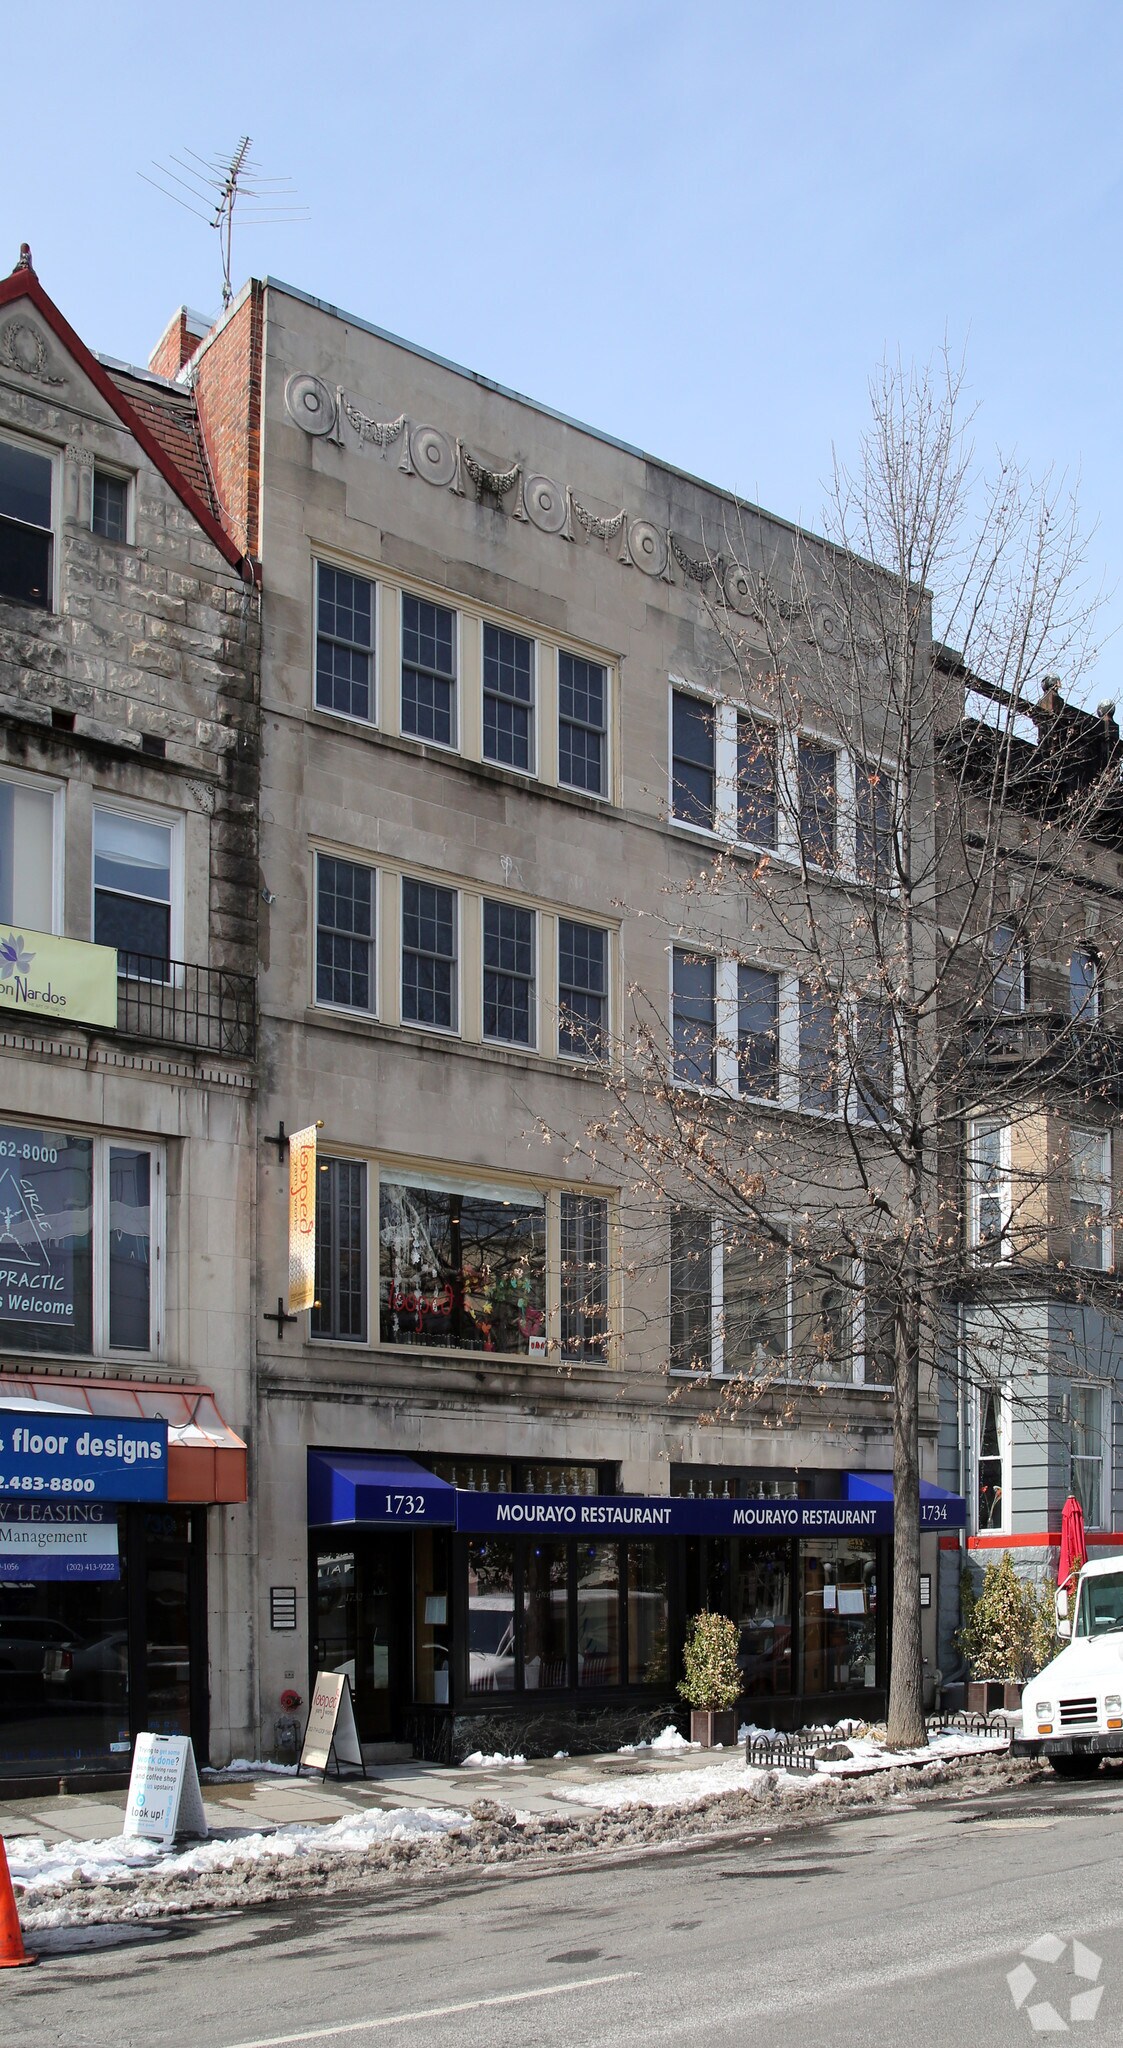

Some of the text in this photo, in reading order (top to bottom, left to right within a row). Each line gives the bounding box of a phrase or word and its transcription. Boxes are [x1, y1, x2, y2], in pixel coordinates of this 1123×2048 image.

[14, 975, 67, 1007] Nardos
[0, 1140, 57, 1164] 62-8000
[290, 1145, 315, 1235] looped
[20, 1179, 52, 1232] CIRCLE
[8, 1294, 74, 1315] Welcome
[387, 1279, 455, 1334] looped
[12, 1428, 69, 1455] floor
[76, 1432, 162, 1463] designs
[17, 1504, 104, 1522] LEASING
[385, 1494, 426, 1515] 1732
[497, 1504, 672, 1525] MOURAYO RESTAURANT
[921, 1504, 948, 1521] 1734
[733, 1509, 877, 1525] MOURAYO RESTAURANT
[0, 1528, 88, 1547] Management
[66, 1562, 84, 1572] (202)
[85, 1563, 115, 1571] 413-9222
[137, 1755, 180, 1766] work done?
[154, 1765, 166, 1773] living
[146, 1773, 162, 1781] coffee
[163, 1774, 177, 1783] shop
[131, 1806, 165, 1821] look up!
